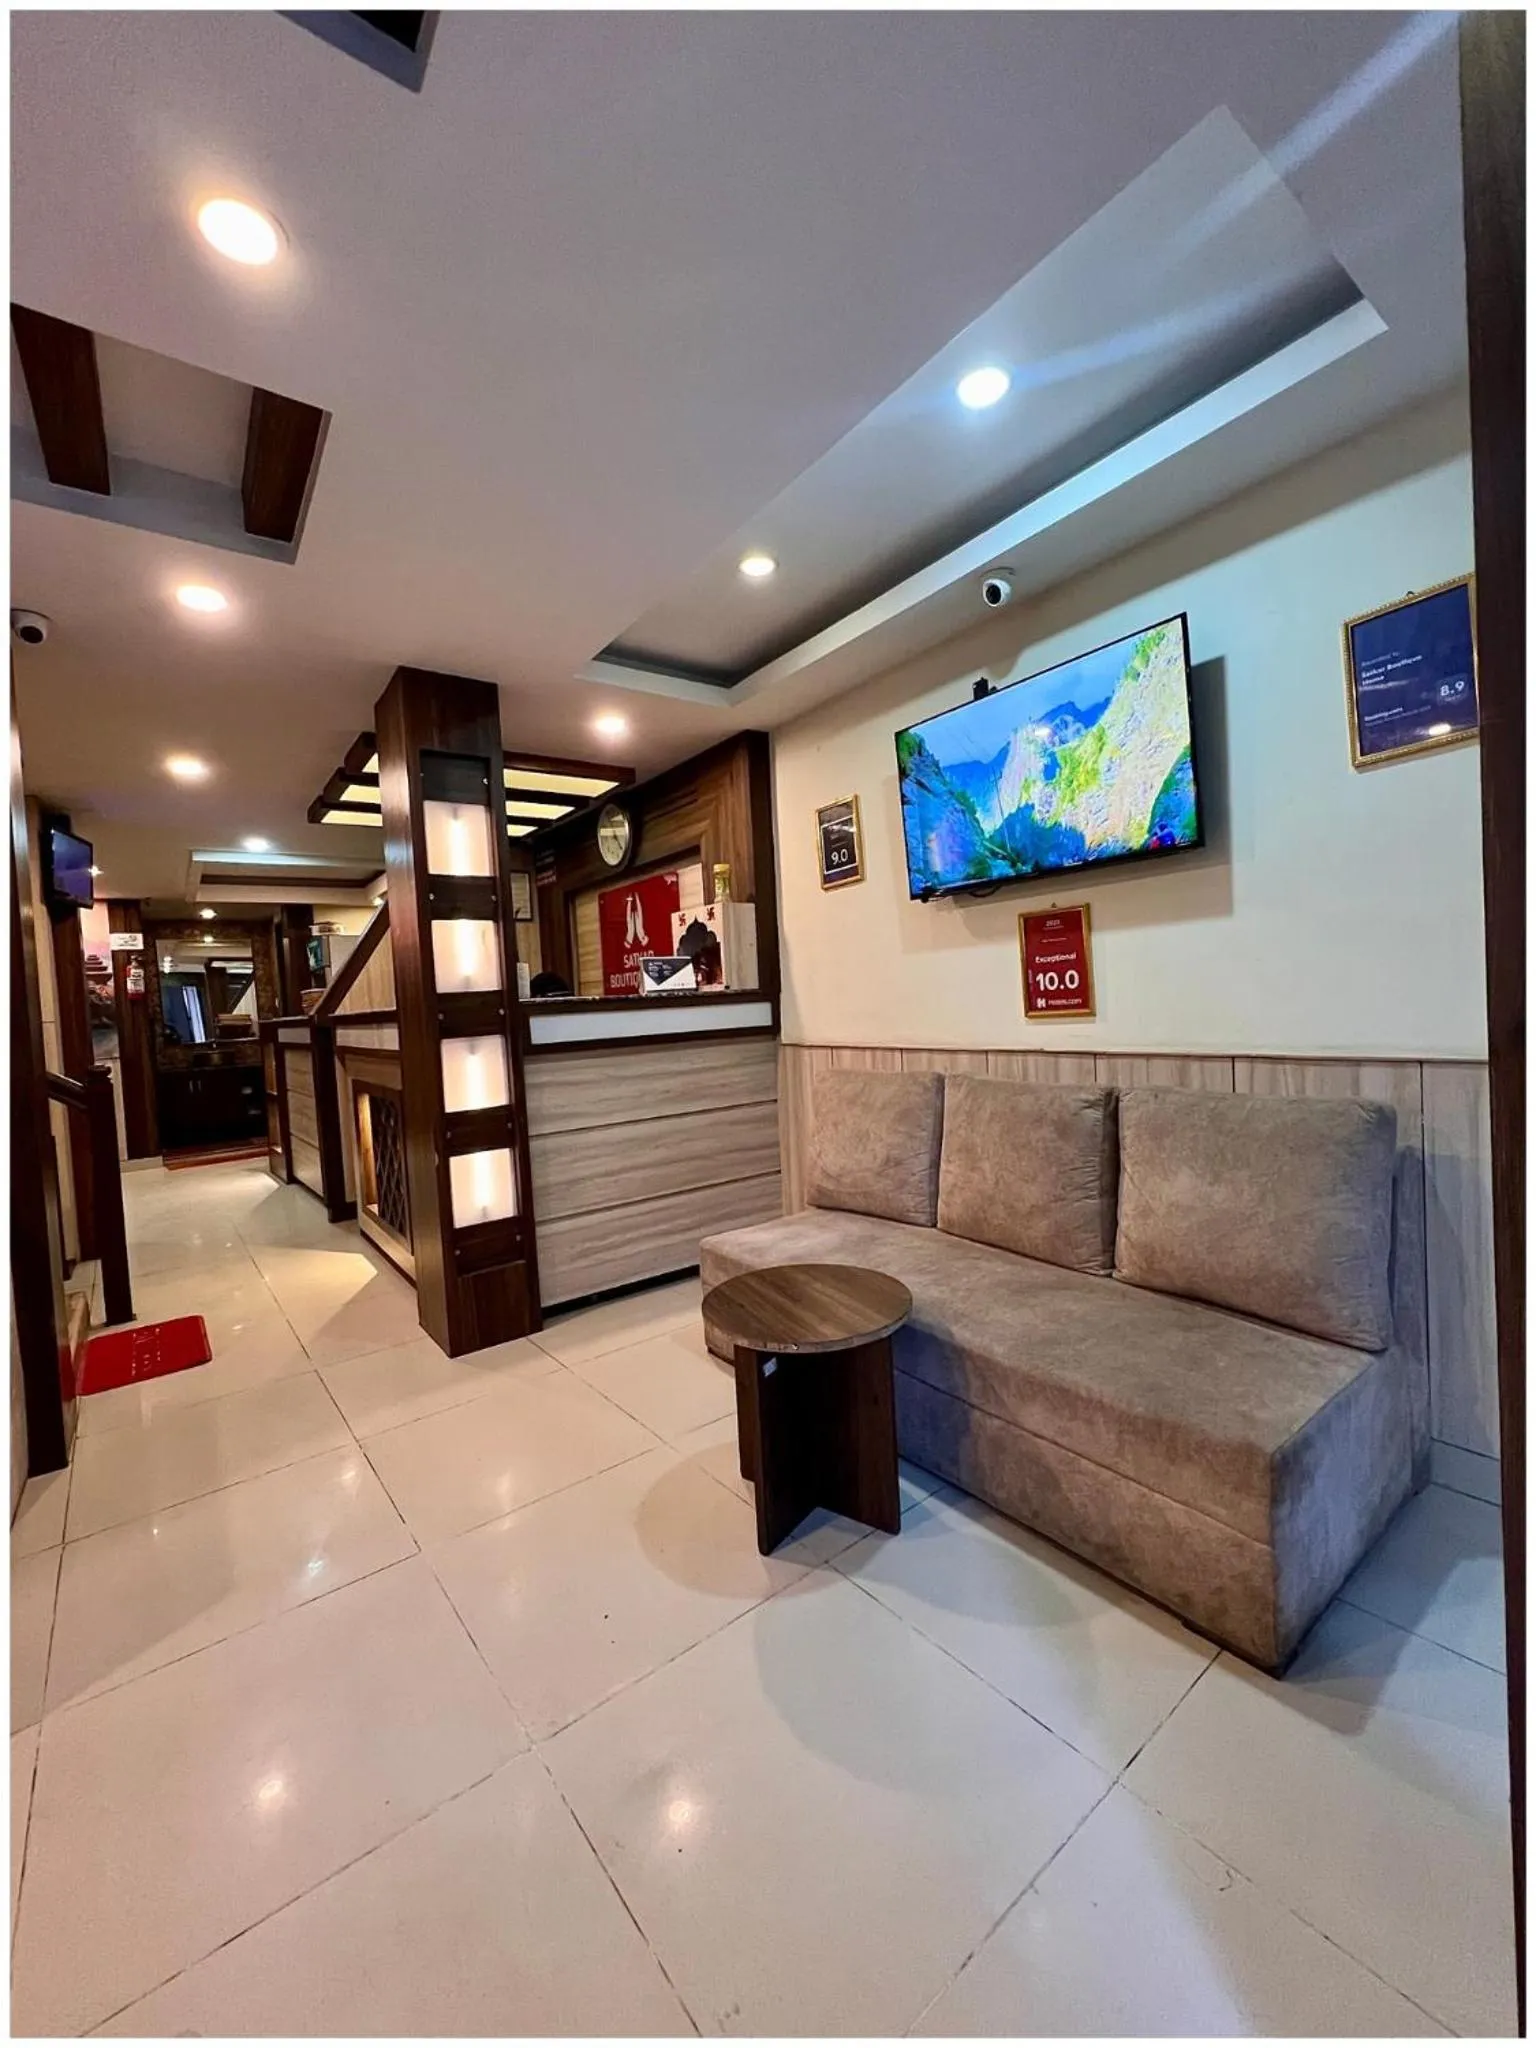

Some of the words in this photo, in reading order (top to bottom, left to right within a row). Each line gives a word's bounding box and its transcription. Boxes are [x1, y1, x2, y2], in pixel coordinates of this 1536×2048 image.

[1440, 680, 1465, 696] 8.9
[831, 848, 848, 865] 9.0
[1035, 952, 1077, 963] Exceptional
[610, 971, 640, 988] BOUTIQ
[1036, 969, 1079, 991] 10.0
